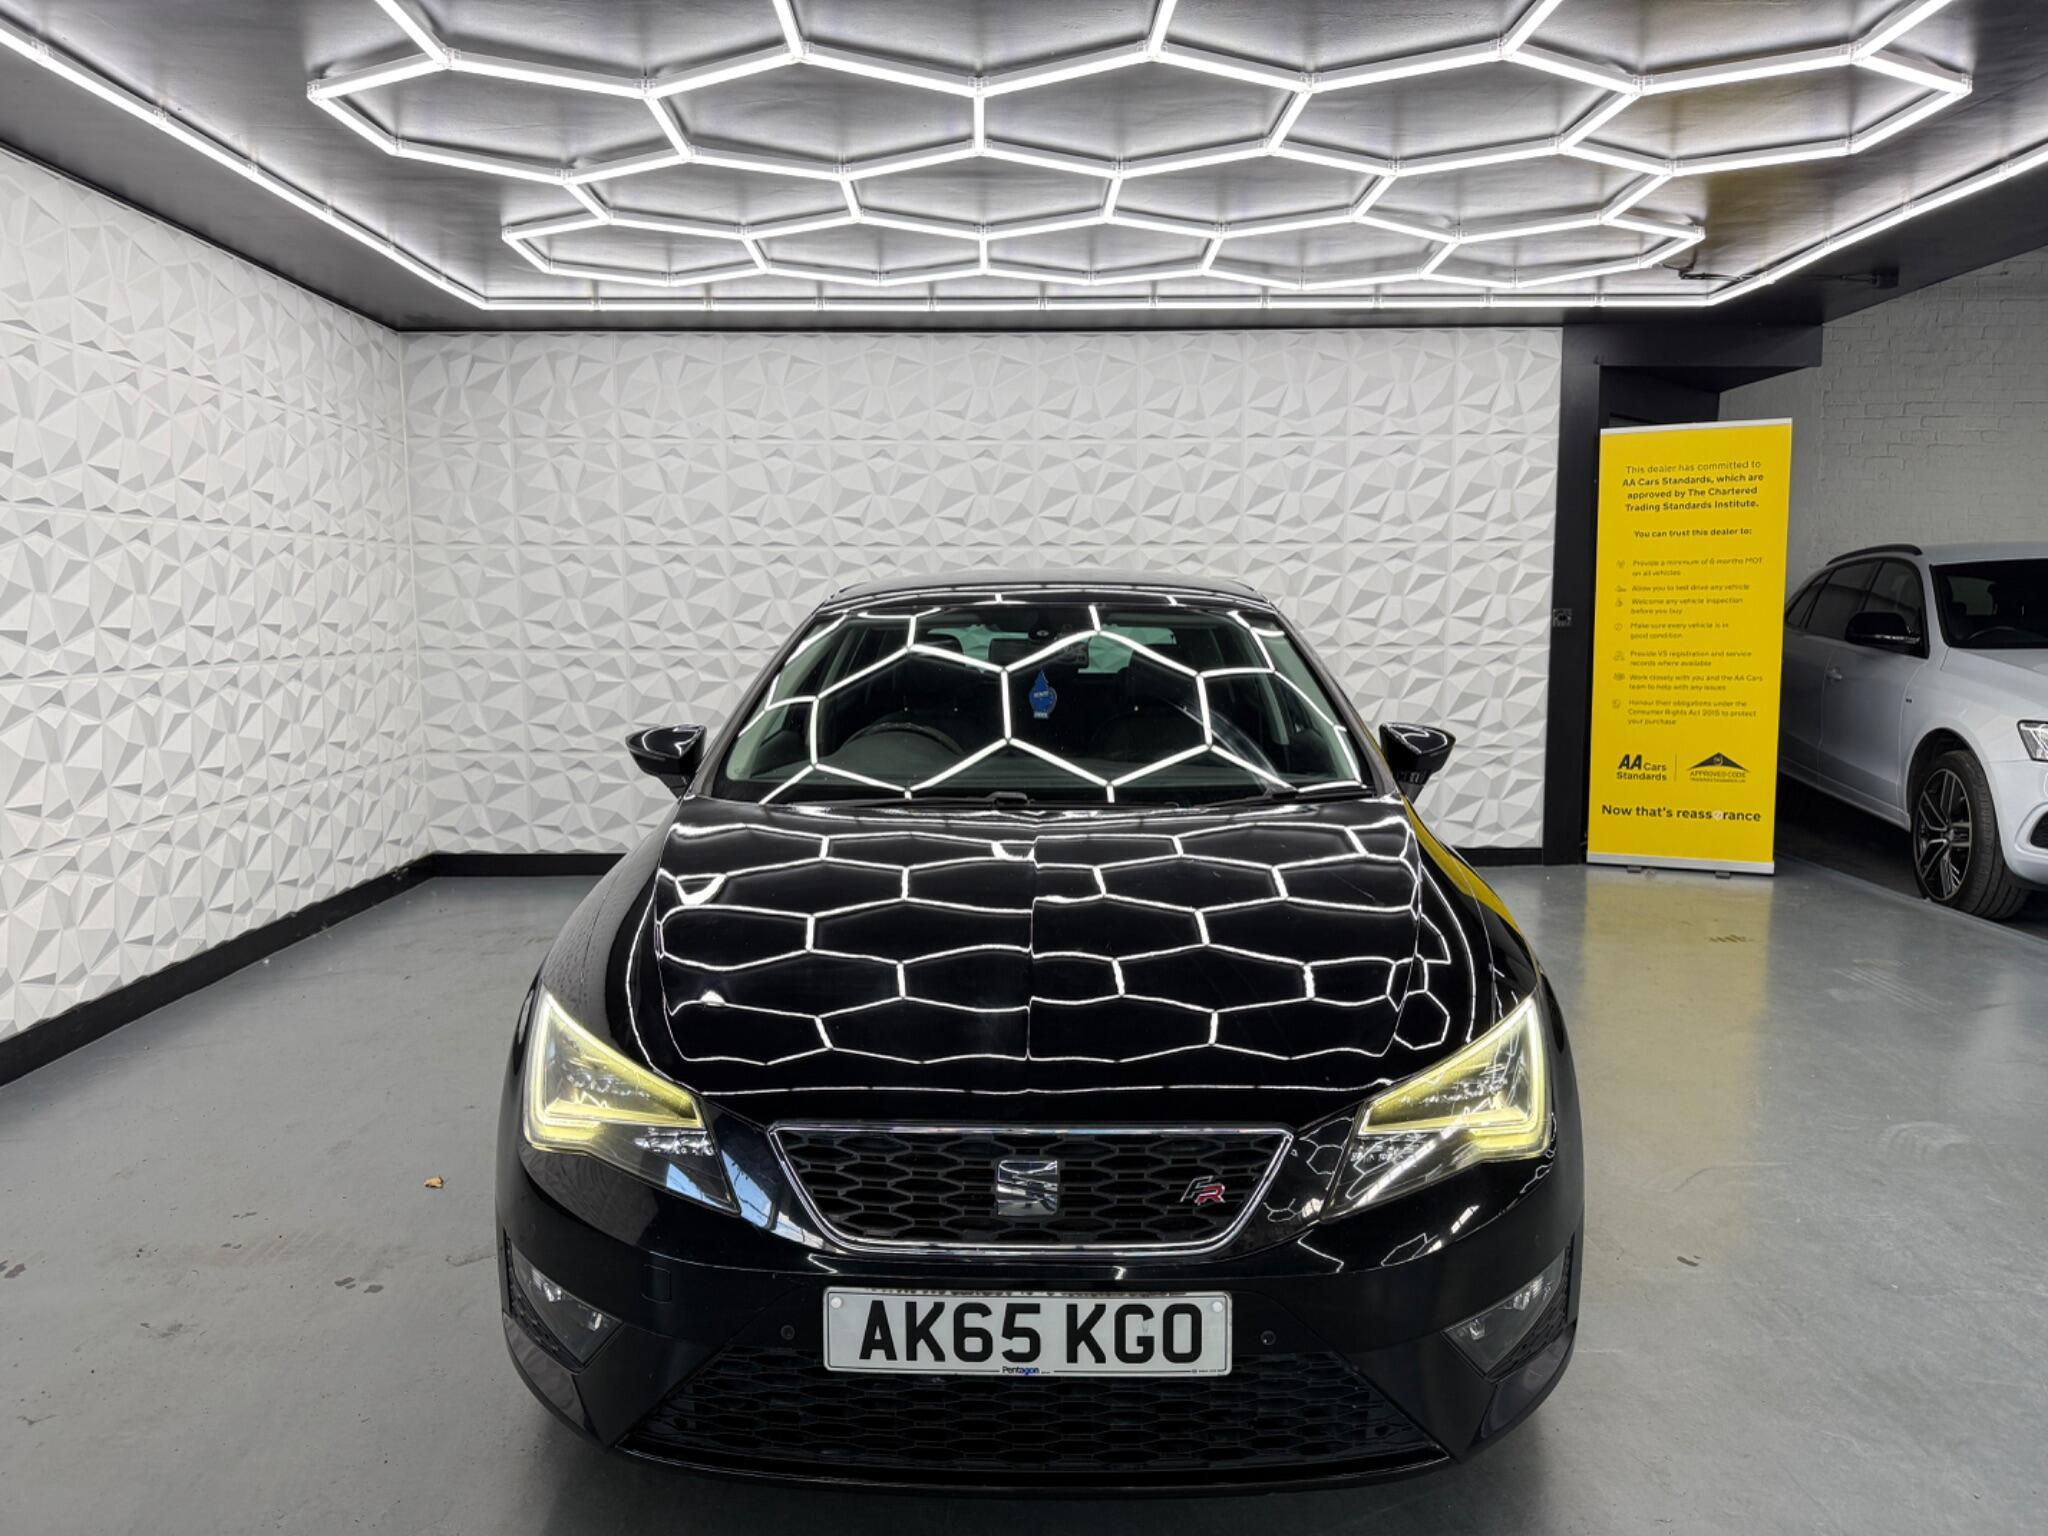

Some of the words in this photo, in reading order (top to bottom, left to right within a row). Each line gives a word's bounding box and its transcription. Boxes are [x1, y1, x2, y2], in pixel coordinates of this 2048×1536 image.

[1626, 466, 1645, 474] This
[1648, 465, 1676, 473] dealer
[1697, 461, 1748, 471] committed
[1751, 460, 1761, 468] to
[1638, 478, 1660, 486] Cars
[1662, 475, 1714, 485] Standards,
[1717, 474, 1746, 482] which
[1628, 490, 1671, 500] approved
[1675, 490, 1686, 498] by
[1708, 487, 1757, 495] Chartered
[1626, 503, 1660, 512] Trading
[1663, 501, 1711, 510] Standards
[1715, 500, 1758, 508] Institute.
[1635, 530, 1650, 538] You
[1711, 528, 1737, 536] dealer
[1706, 597, 1743, 605] inspection
[1665, 709, 1687, 717] Rights
[1731, 710, 1756, 718] protect
[1618, 754, 1643, 770] AA
[1644, 763, 1667, 771] Cars
[1617, 772, 1667, 781] Standards
[1690, 770, 1727, 778] APPROVED
[1602, 805, 1632, 816] Now
[1636, 806, 1673, 818] that's
[859, 1300, 1041, 1363] AK65
[1066, 1303, 1203, 1364] KGO
[1002, 1366, 1040, 1375] Pentagon
